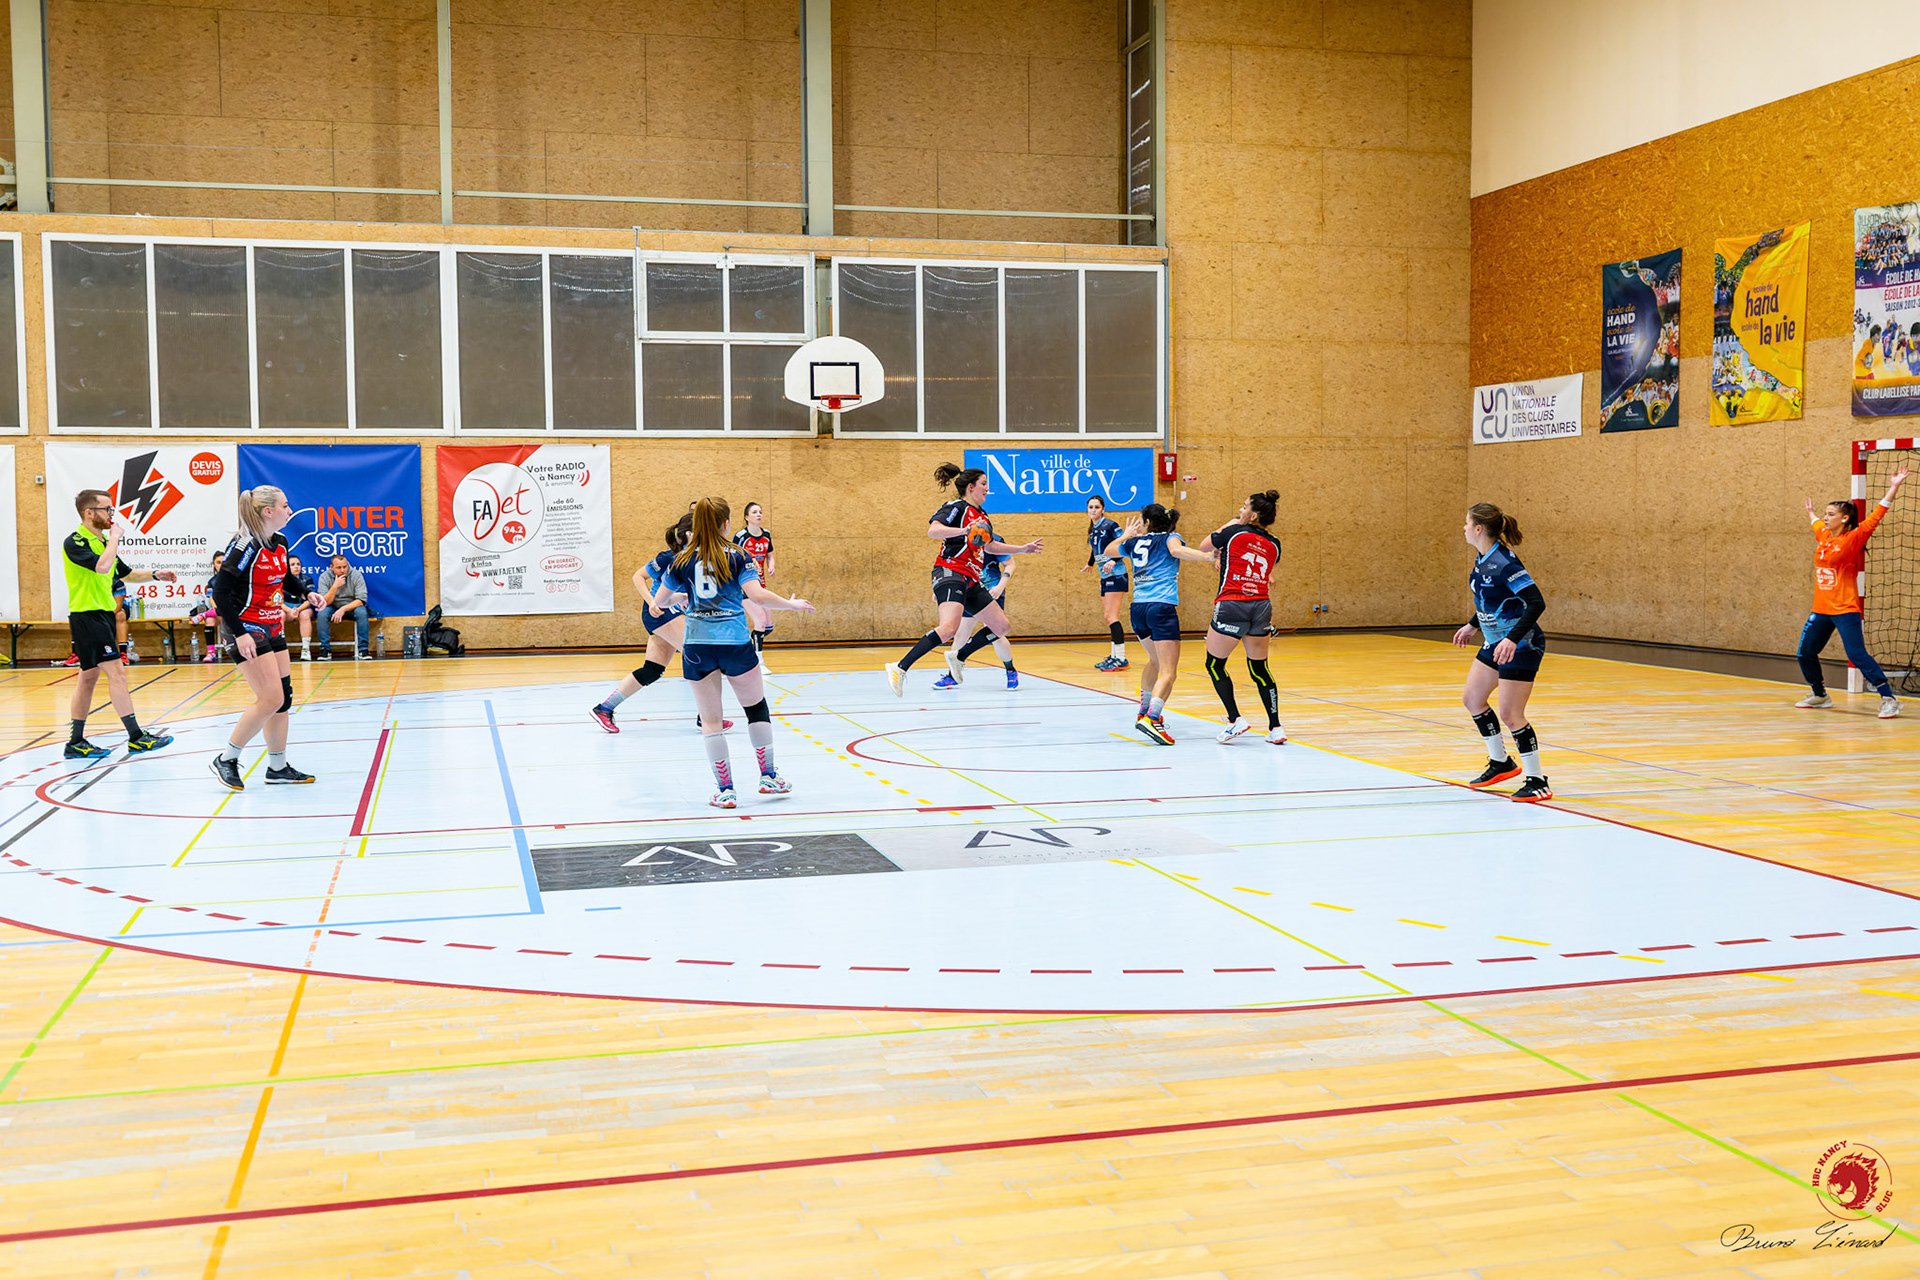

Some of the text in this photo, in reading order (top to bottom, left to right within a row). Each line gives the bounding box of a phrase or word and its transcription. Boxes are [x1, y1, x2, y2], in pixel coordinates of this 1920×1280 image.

[1885, 270, 1904, 286] ÉCOLE
[1905, 269, 1913, 282] DE
[1884, 286, 1903, 302] ÉCOLE
[1904, 286, 1912, 298] DE
[1745, 285, 1779, 318] hand
[1885, 301, 1903, 312] SAISON
[1607, 312, 1636, 327] HAND
[1760, 315, 1795, 346] la vie
[1607, 333, 1636, 347] LA VIE
[1512, 385, 1535, 397] UNION
[1863, 388, 1879, 399] CLUB
[1512, 395, 1556, 411] NATIONALE
[1512, 409, 1554, 424] DES CLUBS
[1511, 421, 1577, 438] UNIVERSITAIRES
[192, 461, 221, 470] DEVIS
[526, 461, 585, 473] Votre RADIO
[1040, 454, 1091, 469] ville de
[539, 472, 575, 482] à Nancy
[982, 453, 1138, 506] Nancy
[318, 506, 405, 529] INTER
[504, 525, 524, 534] 94.2
[315, 531, 408, 557] SPORT
[755, 542, 764, 552] 23
[134, 548, 153, 556] pour
[181, 548, 207, 557] projet
[461, 554, 500, 563] Programmes
[1132, 539, 1152, 568] 5
[151, 562, 190, 571] Dépannage
[482, 565, 527, 578] WWW.FAJET.NET
[694, 559, 719, 600] 6
[136, 585, 158, 598] 48
[165, 585, 186, 598] 34
